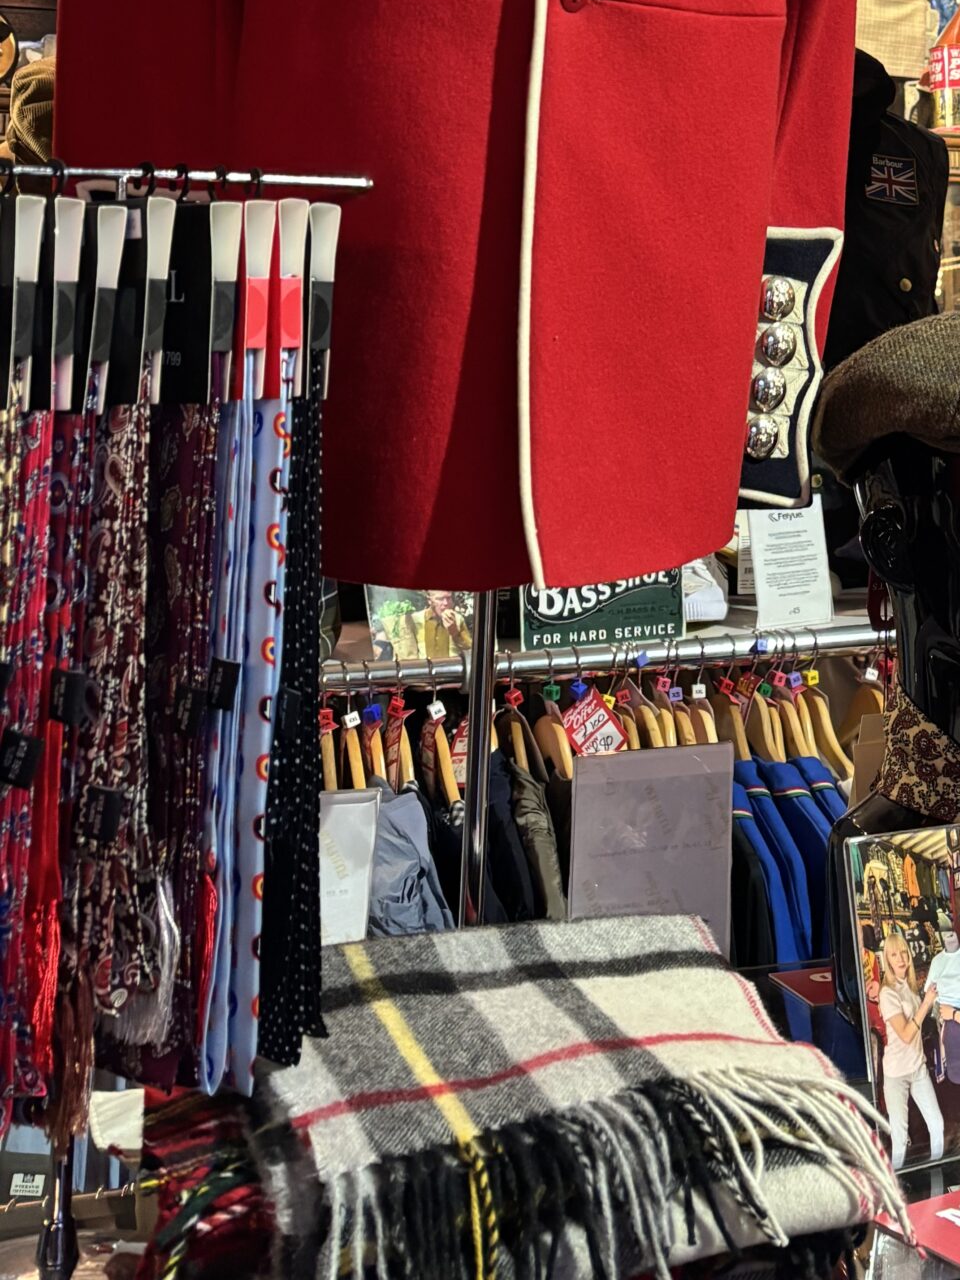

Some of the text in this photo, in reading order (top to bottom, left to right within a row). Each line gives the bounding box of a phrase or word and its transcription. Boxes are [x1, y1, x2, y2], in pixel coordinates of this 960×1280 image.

[873, 157, 904, 168] Barbour
[533, 623, 676, 646] FOR HARD SERVICE
[573, 700, 598, 729] Offer
